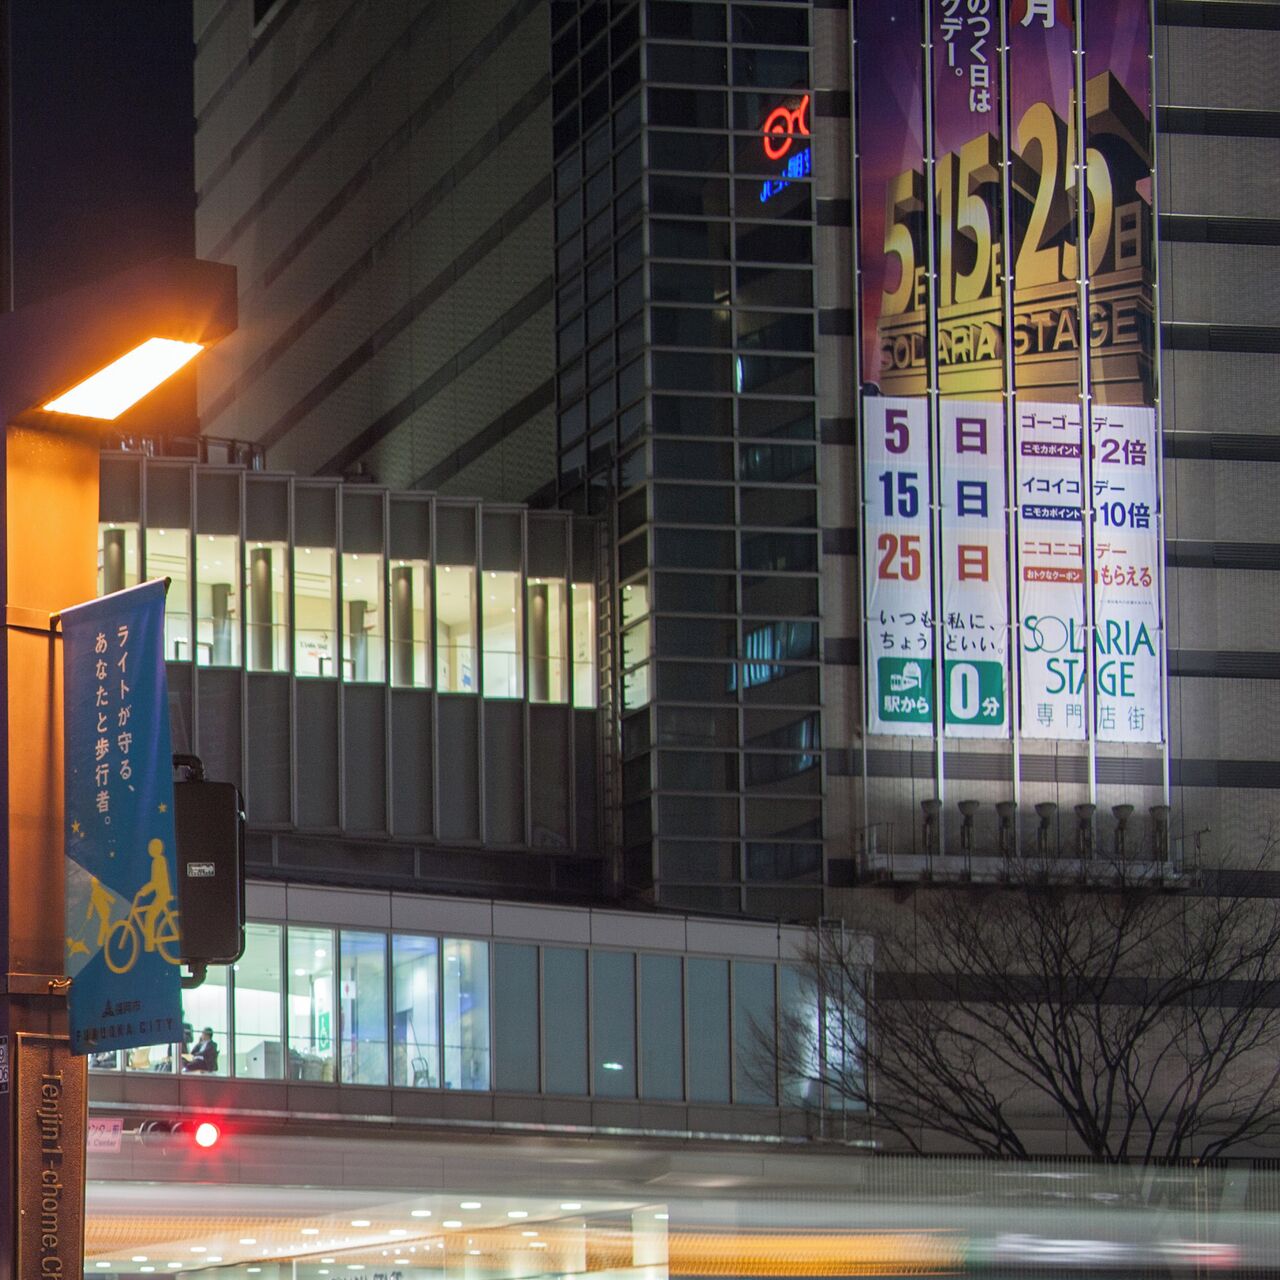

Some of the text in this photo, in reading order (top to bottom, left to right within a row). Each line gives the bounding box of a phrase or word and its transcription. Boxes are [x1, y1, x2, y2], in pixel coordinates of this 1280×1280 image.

[881, 303, 1139, 371] SOLARIA STAGE
[1101, 438, 1147, 466] 2倍
[1100, 501, 1150, 529] 10倍
[1101, 566, 1153, 588] もらえる
[1024, 615, 1156, 657] SOLARIA
[1046, 658, 1136, 697] STAGE
[118, 625, 135, 792] ライトが守る、
[884, 695, 930, 715] 駅から
[1036, 702, 1146, 732] 専門店街
[95, 632, 111, 825] あなたと歩行者。
[139, 1018, 173, 1034] CITY
[37, 1069, 64, 1140] Tenjin
